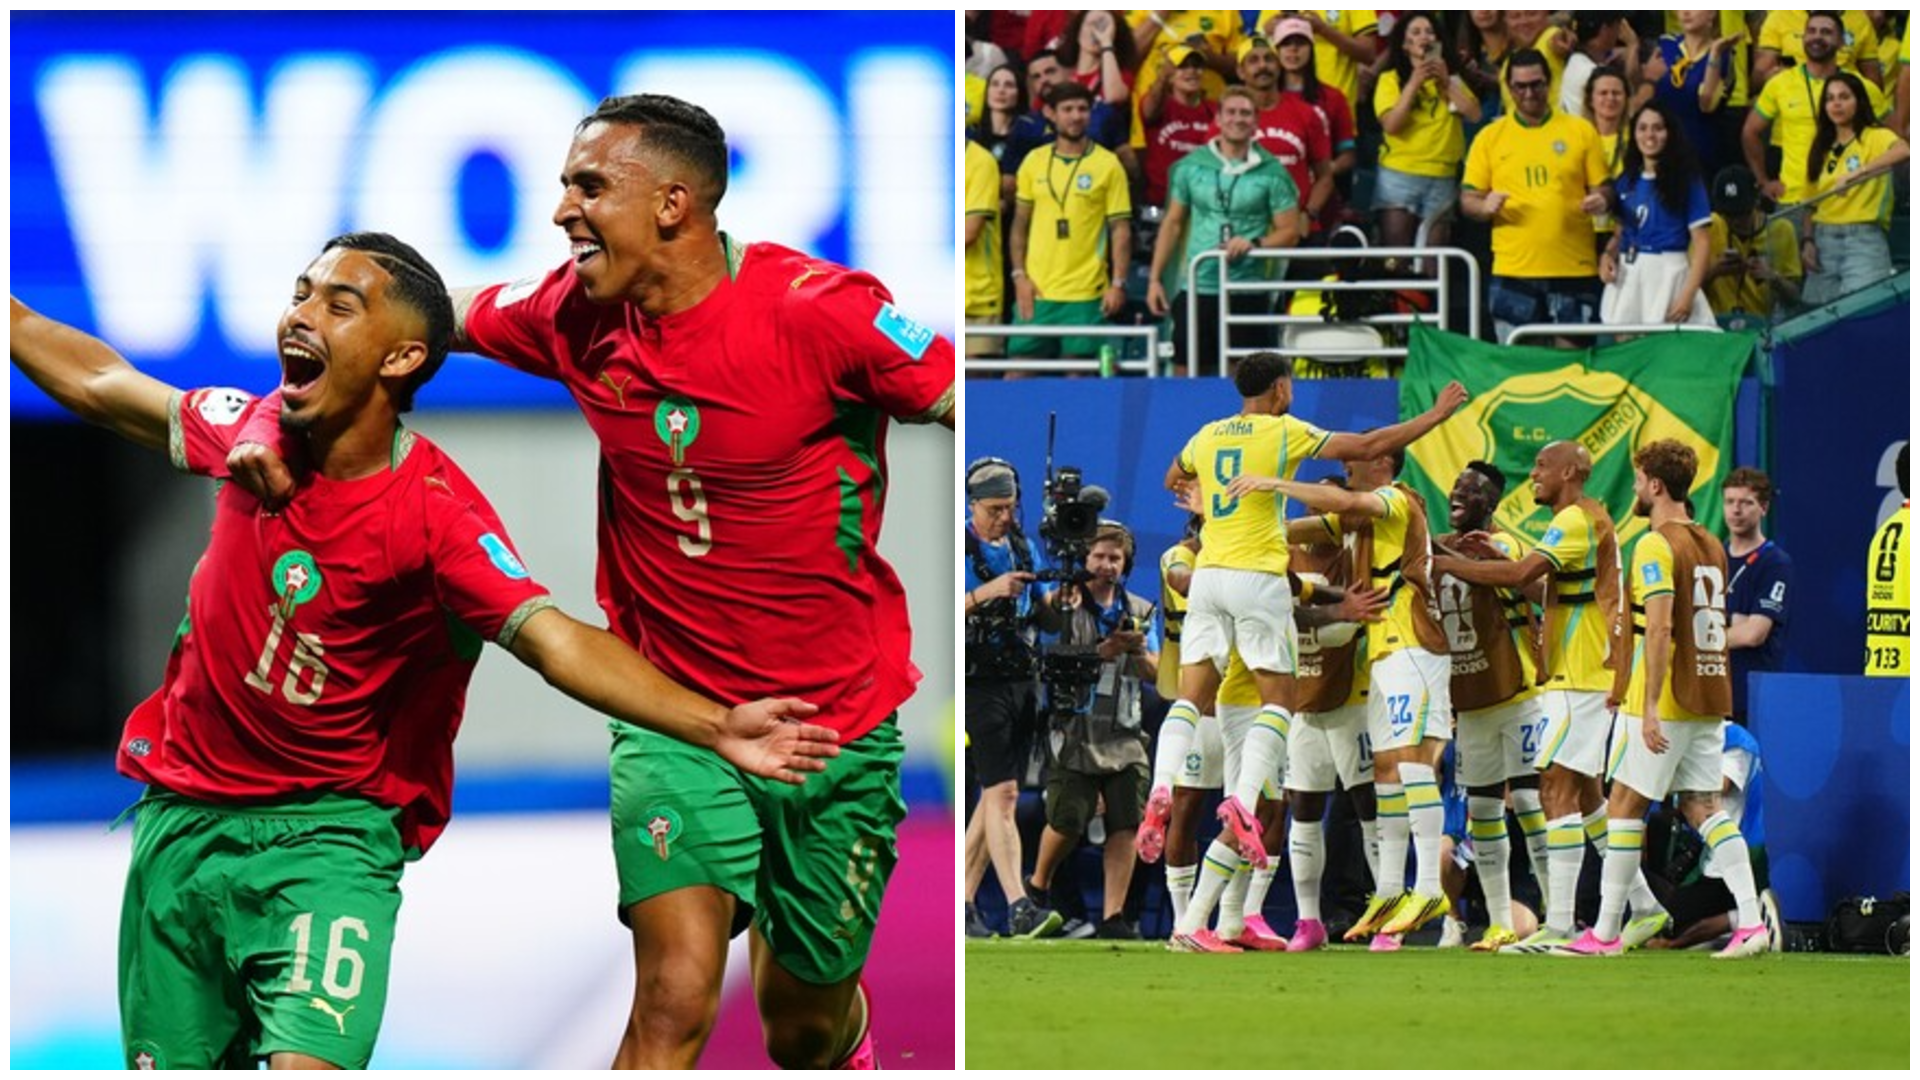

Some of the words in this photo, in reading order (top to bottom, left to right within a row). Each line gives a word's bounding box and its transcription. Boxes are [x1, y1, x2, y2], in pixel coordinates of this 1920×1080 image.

[1525, 166, 1548, 187] 10
[1513, 426, 1552, 441] E.C.
[1583, 402, 1636, 455] EMBRO
[1212, 448, 1242, 518] 9
[666, 469, 713, 557] 9
[1502, 496, 1524, 521] XV
[244, 602, 330, 705] 16
[1696, 663, 1727, 677] 202
[1387, 694, 1413, 725] 22
[285, 911, 370, 1000] 16
